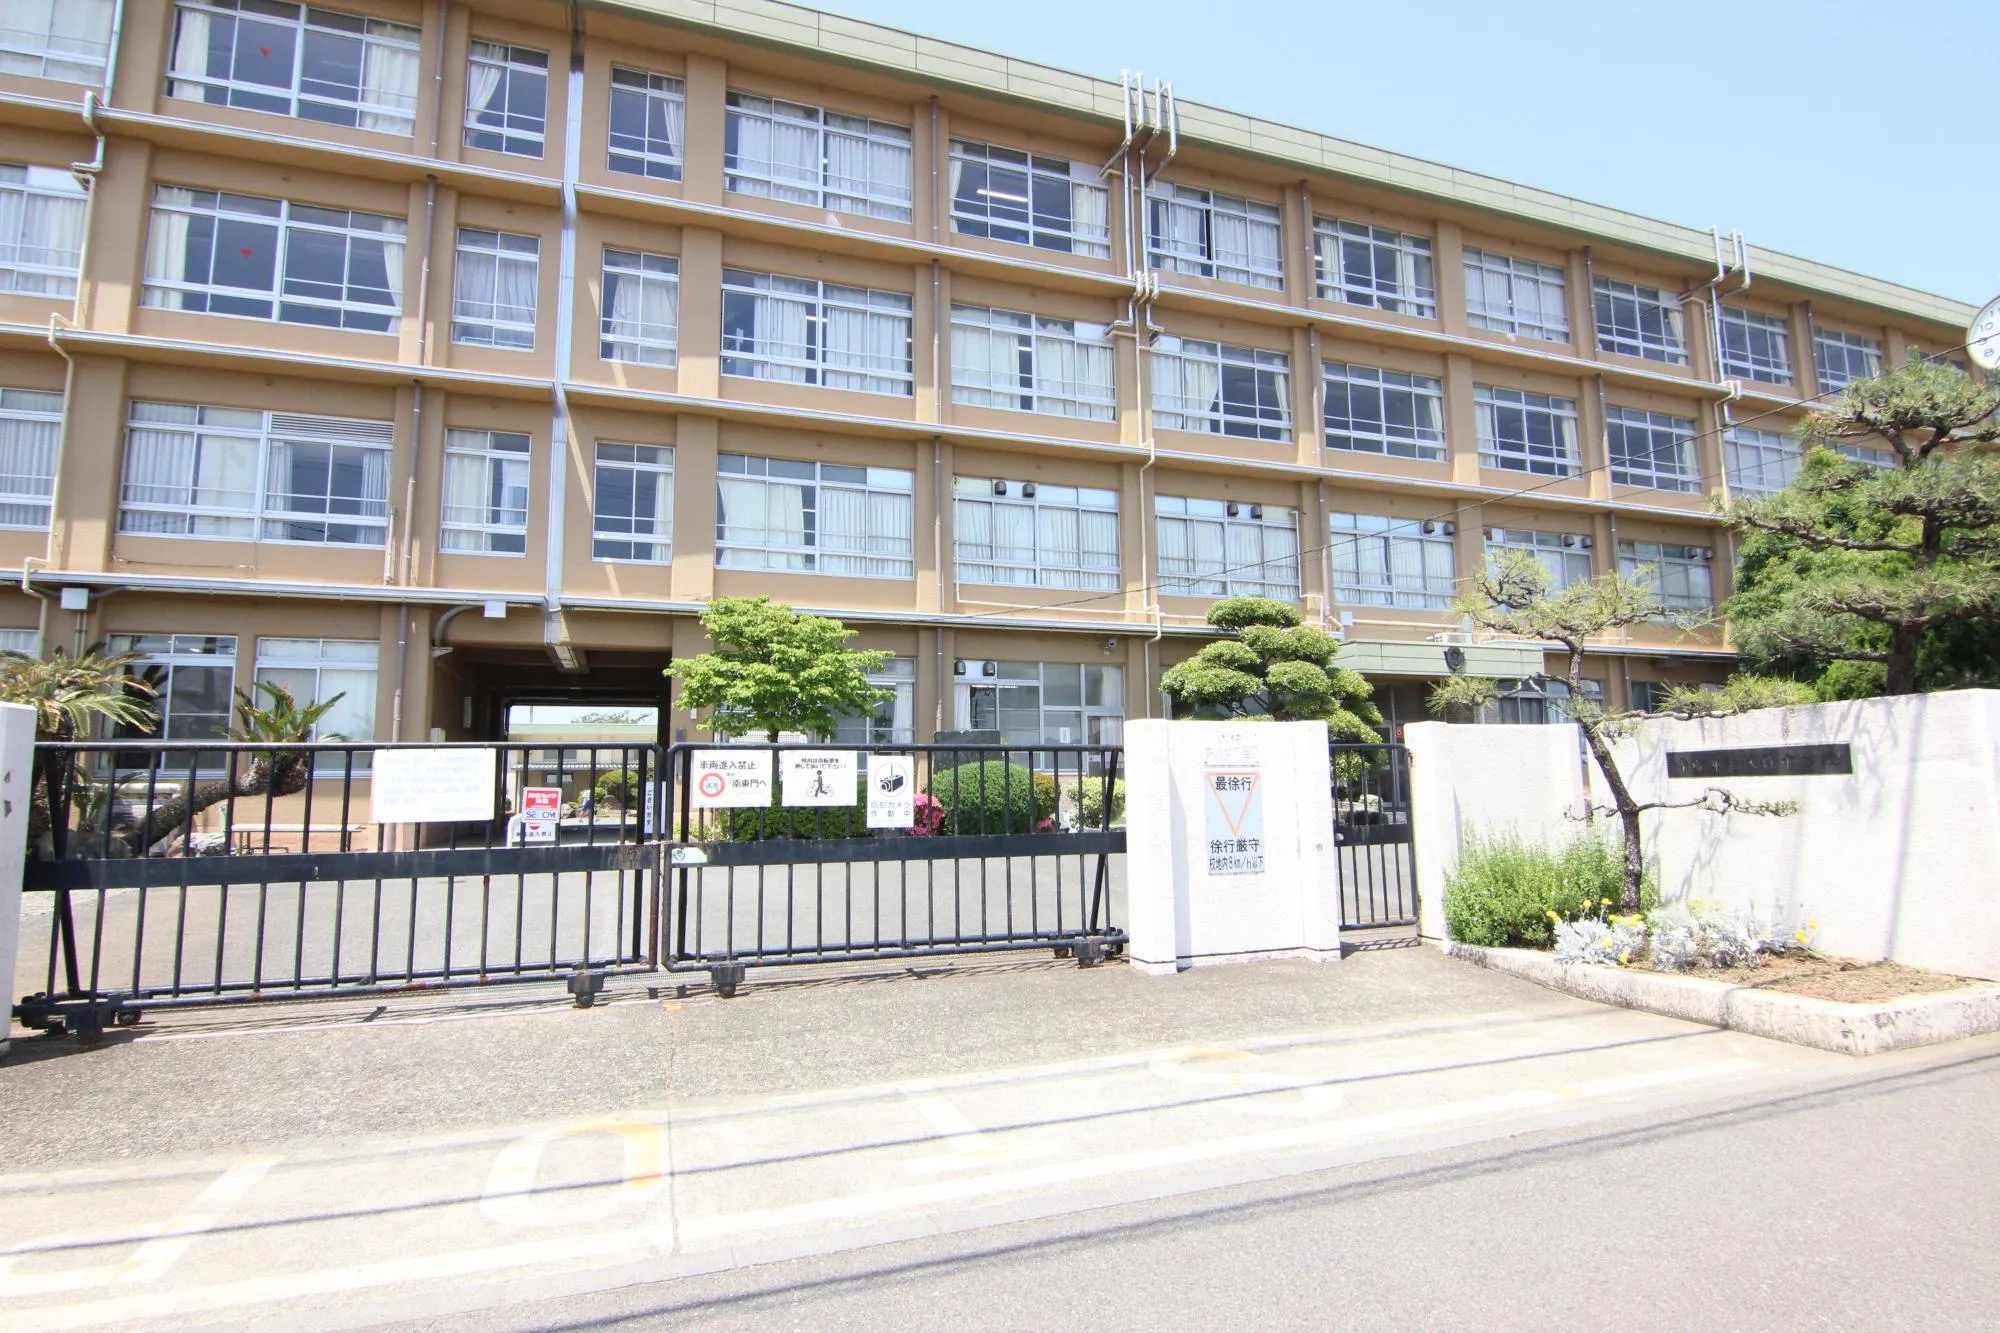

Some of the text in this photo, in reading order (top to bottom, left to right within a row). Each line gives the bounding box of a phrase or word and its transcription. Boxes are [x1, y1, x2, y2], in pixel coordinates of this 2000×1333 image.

[1980, 322, 1994, 333] 10
[1984, 348, 1994, 358] 8
[700, 760, 757, 770] 車両進入禁止
[733, 779, 767, 789] 南東門へ
[1215, 776, 1253, 791] 最徐行
[871, 800, 910, 808] 防犯カメラ
[1210, 838, 1260, 854] 徐行厳守
